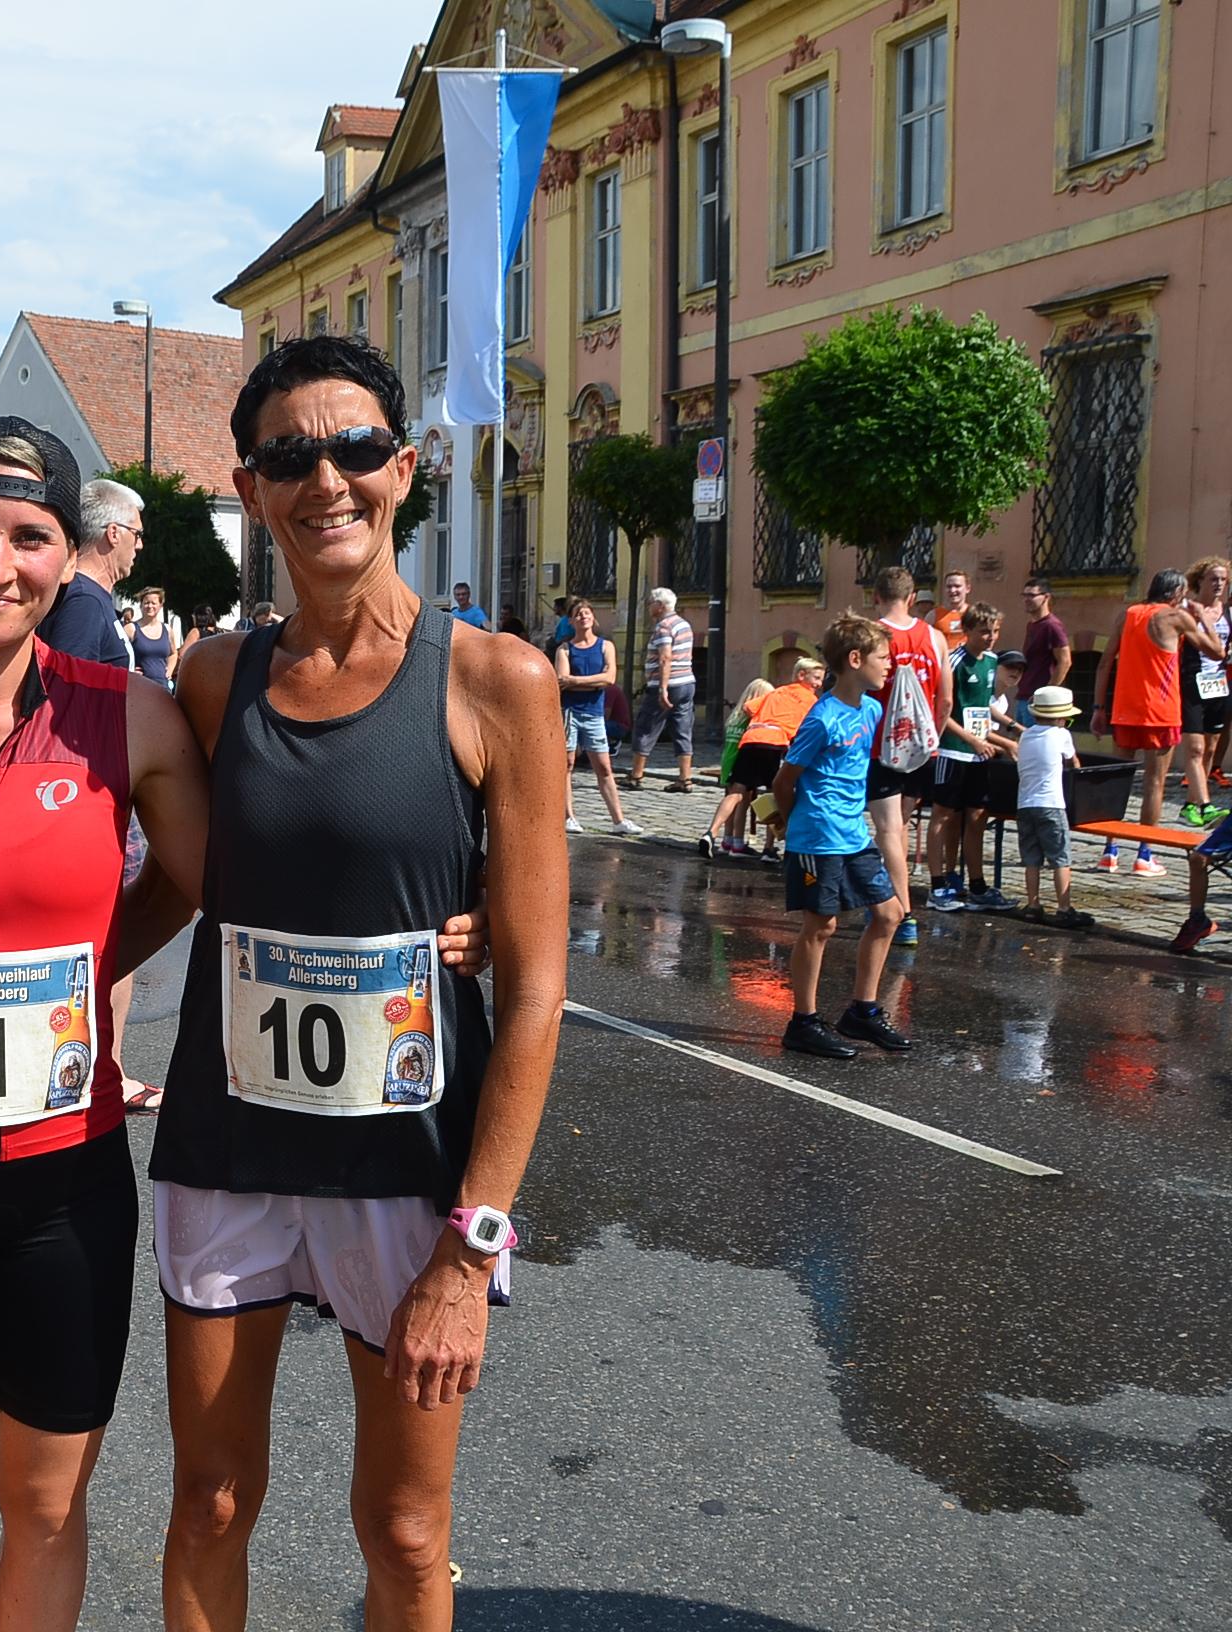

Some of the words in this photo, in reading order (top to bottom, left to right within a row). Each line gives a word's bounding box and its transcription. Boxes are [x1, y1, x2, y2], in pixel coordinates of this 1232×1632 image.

[269, 946, 286, 962] 30.
[289, 949, 385, 968] Kirchweihlauf
[288, 967, 358, 989] Allersberg
[258, 996, 347, 1087] 10
